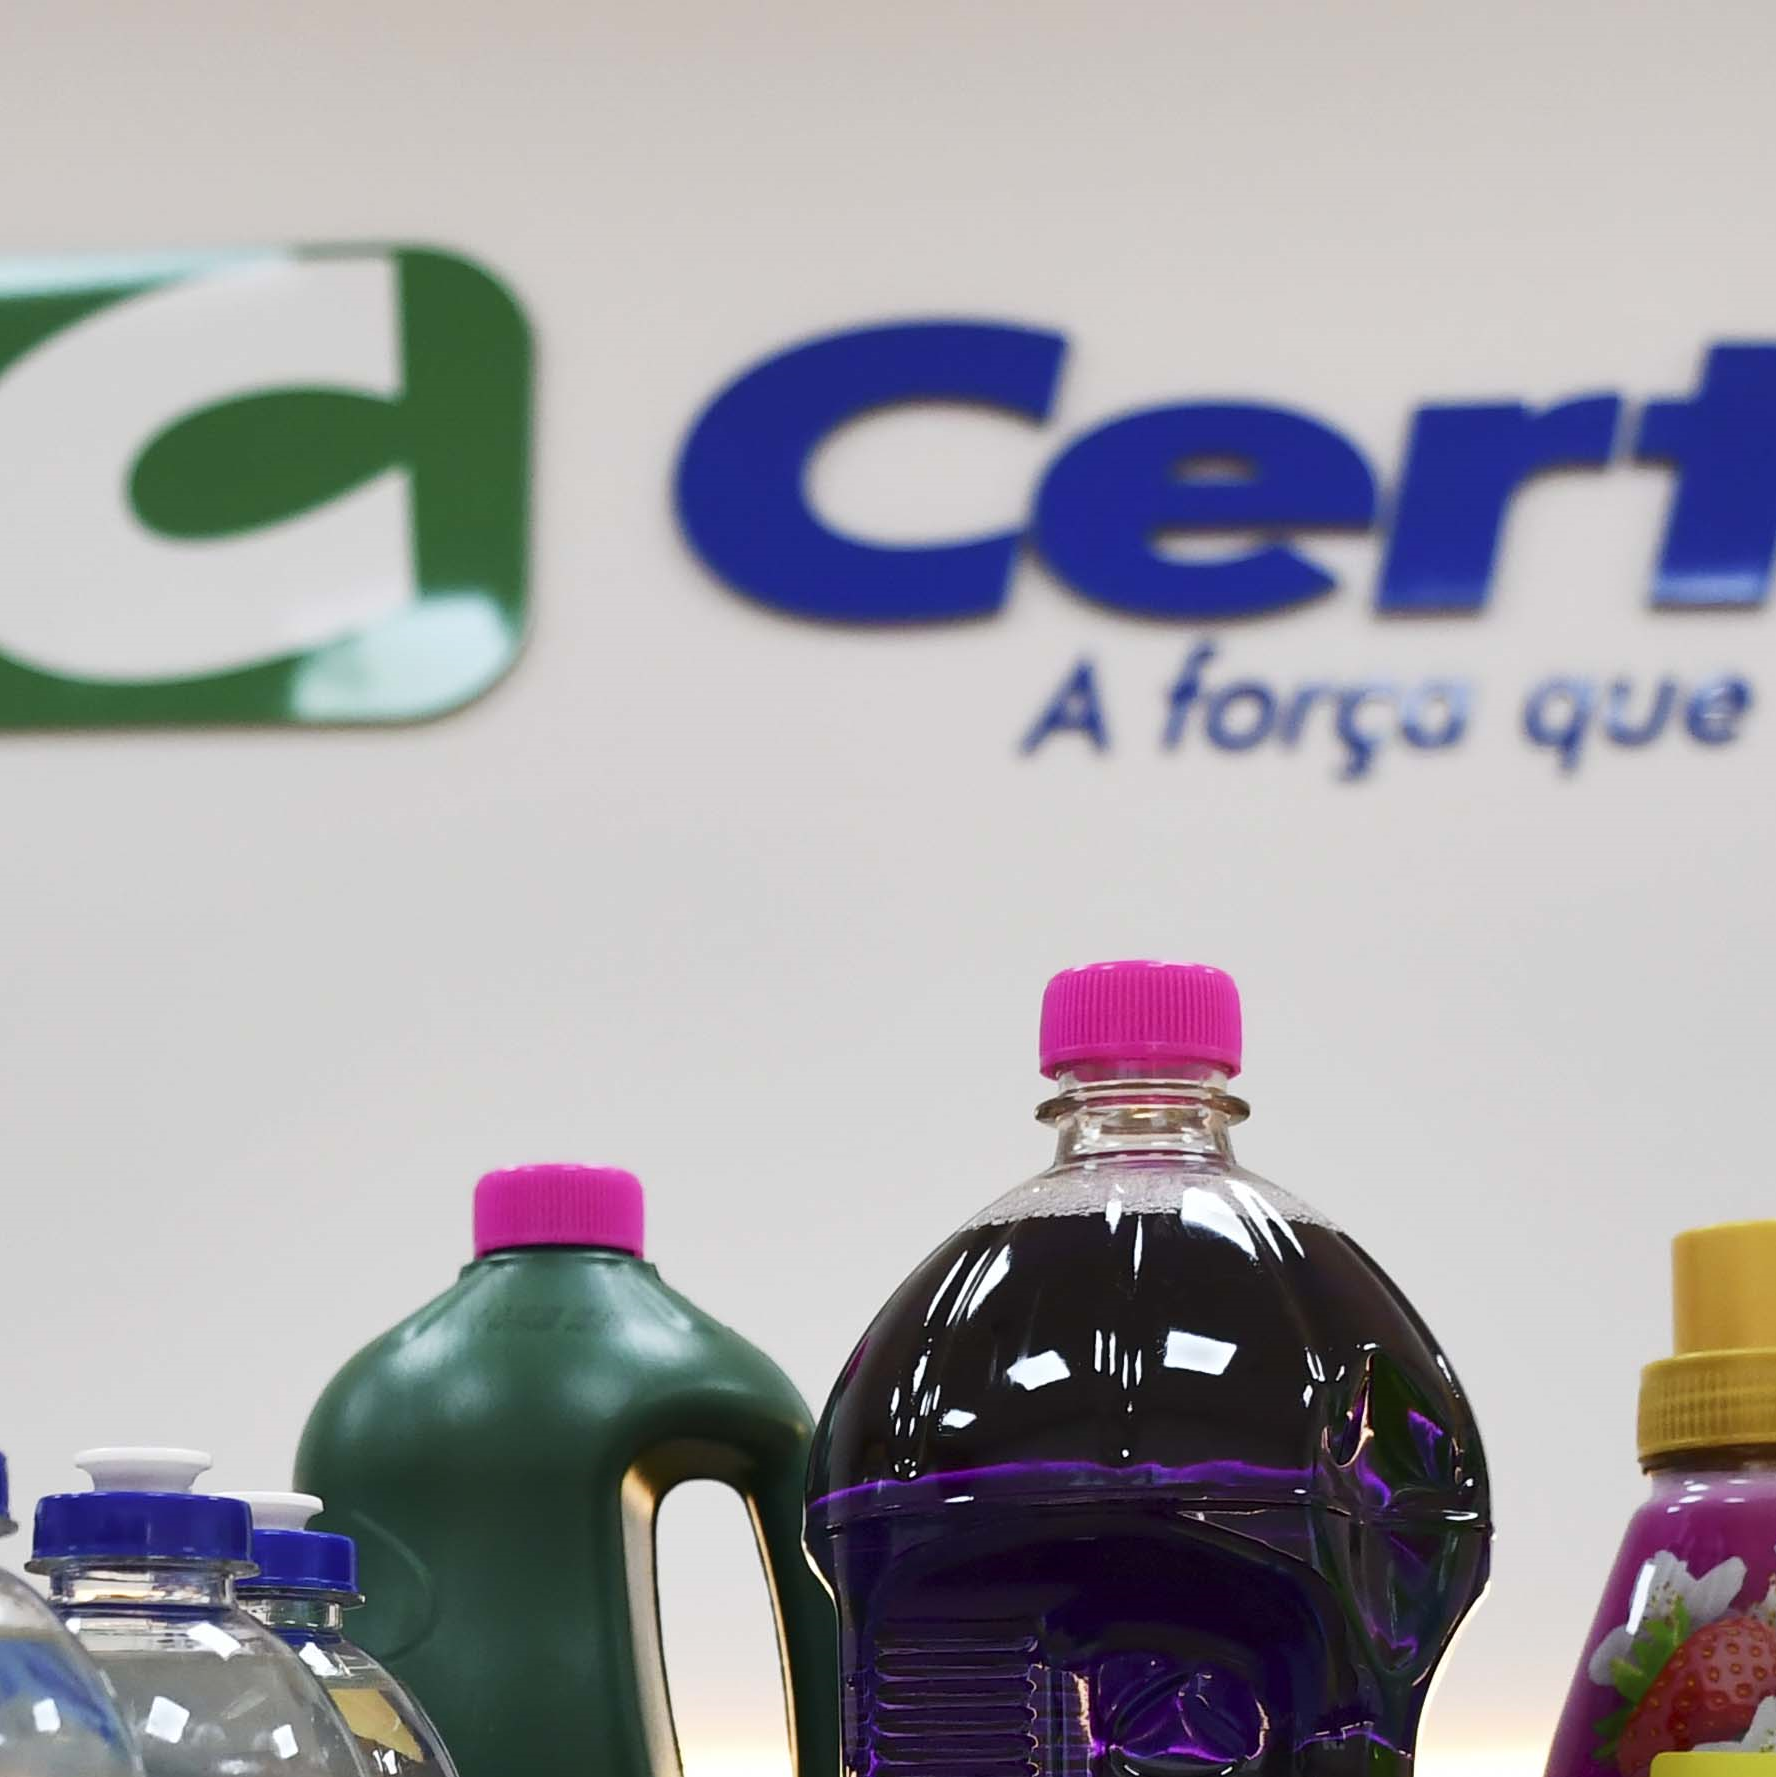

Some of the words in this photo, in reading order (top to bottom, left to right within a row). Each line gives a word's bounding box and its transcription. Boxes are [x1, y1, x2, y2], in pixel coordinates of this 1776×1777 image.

[1019, 659, 1115, 757] A
[1160, 640, 1468, 783] força
[1525, 675, 1749, 775] que
